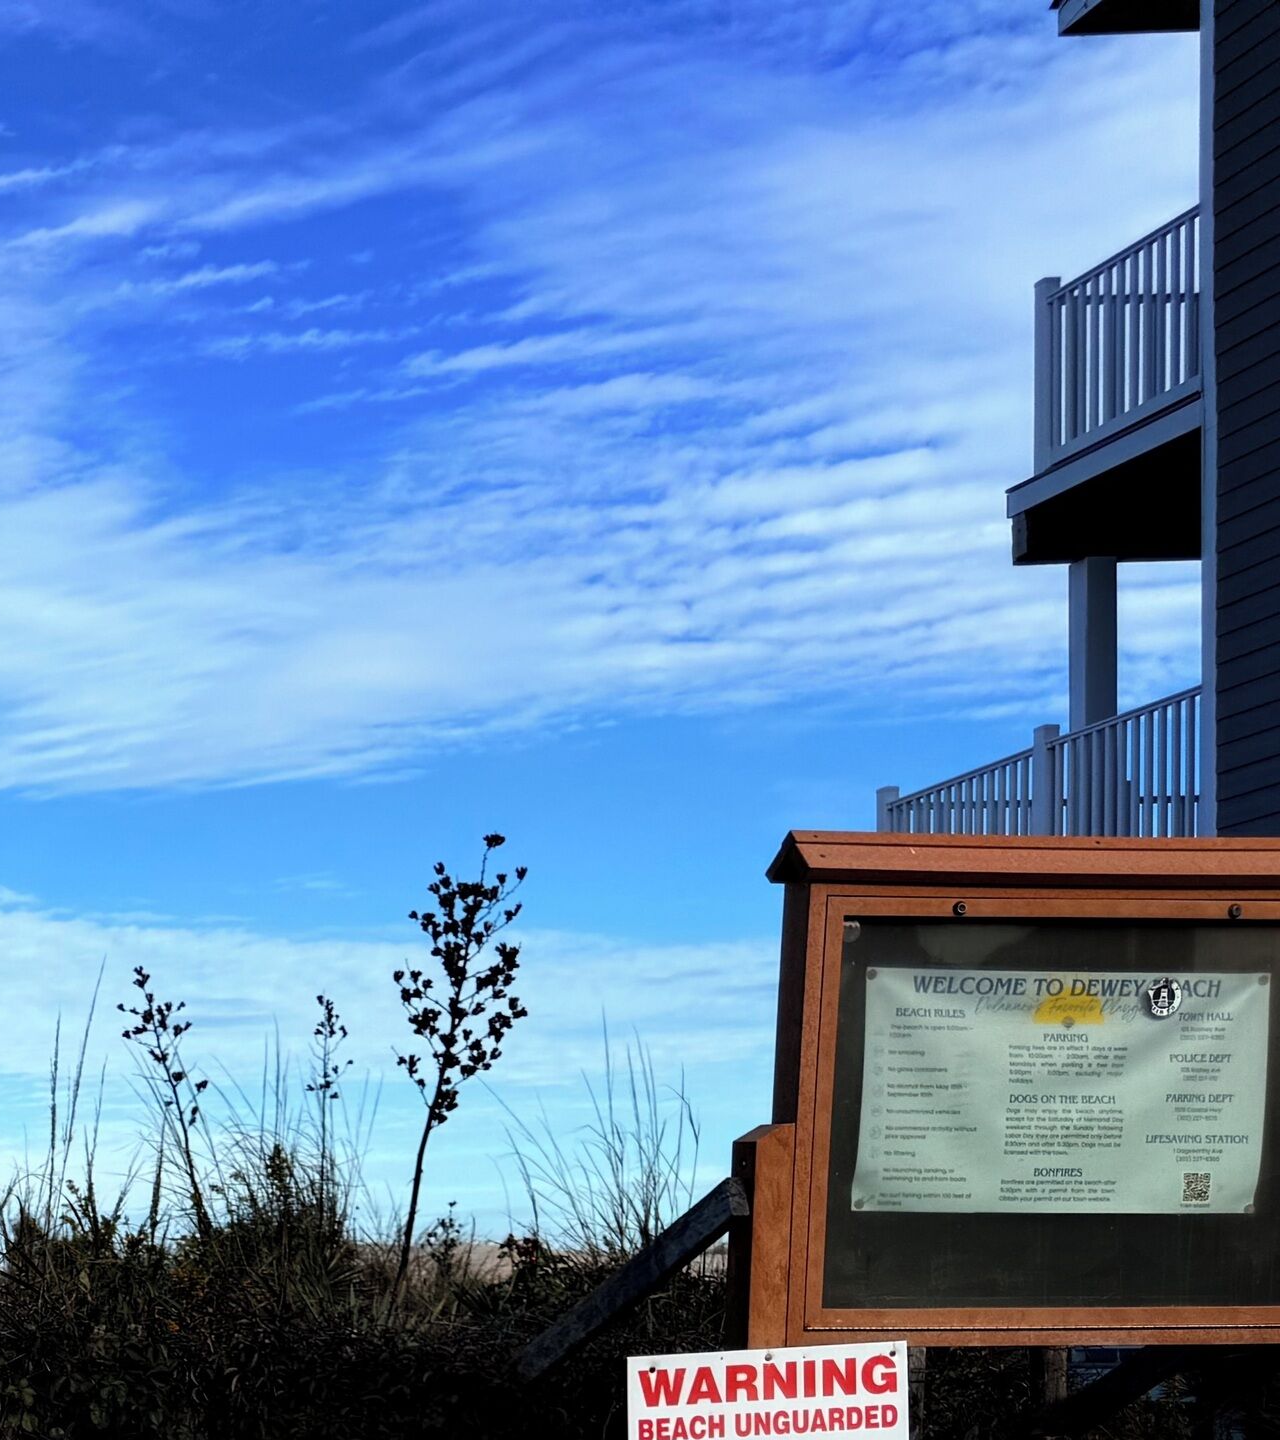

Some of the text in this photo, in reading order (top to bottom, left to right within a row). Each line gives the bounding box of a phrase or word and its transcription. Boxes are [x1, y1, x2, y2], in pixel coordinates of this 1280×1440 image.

[913, 975, 1027, 996] WELCOME
[1032, 978, 1063, 997] TO
[1070, 979, 1147, 997] DEWEY
[895, 1007, 966, 1018] BEACH RULES
[1178, 1011, 1234, 1022] TOWN HALL
[1043, 1033, 1088, 1043] PARKING
[1169, 1053, 1232, 1063] POLICE DEPT
[1009, 1094, 1116, 1104] DOGS ON THE BEACH
[1165, 1093, 1235, 1103] PARKING DEPT
[1145, 1134, 1249, 1144] LIFESAVING STATION
[1033, 1167, 1083, 1177] BONFIRES
[638, 1355, 898, 1408] WARNING
[735, 1405, 898, 1437] UNGUARDED
